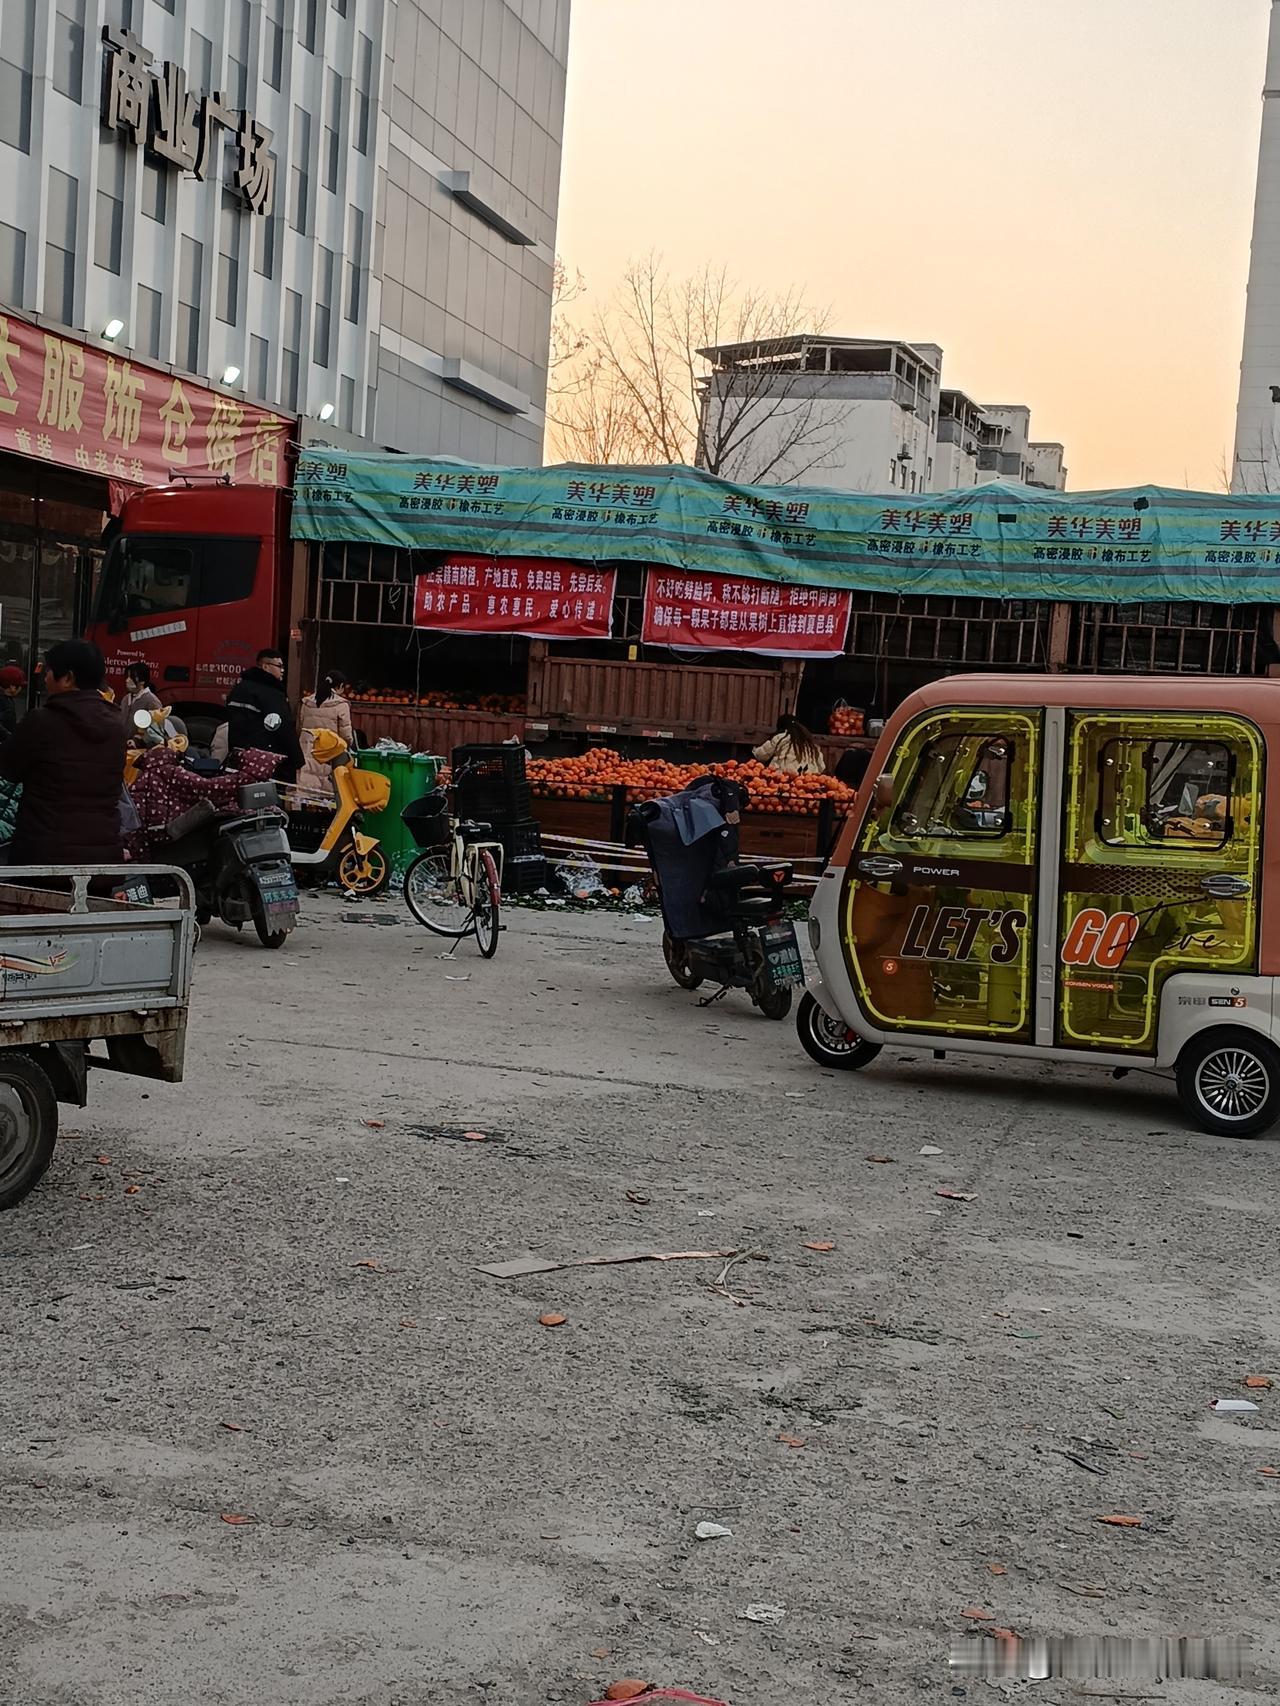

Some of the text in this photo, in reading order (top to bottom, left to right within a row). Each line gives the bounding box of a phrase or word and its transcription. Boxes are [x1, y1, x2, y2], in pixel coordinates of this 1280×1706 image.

[101, 25, 274, 216] 商业广场
[15, 427, 145, 483] 童装 中老年装
[414, 472, 499, 495] 美华美塑
[567, 480, 656, 507] 美华美塑
[399, 496, 505, 516] 高密浸胶 橡布工艺
[614, 512, 658, 525] 橡布工艺
[722, 495, 809, 524] 美华美塑
[707, 521, 817, 547] 高密浸胶 橡布工艺
[881, 509, 972, 535] 美华美塑
[1048, 516, 1142, 541] 美华美塑
[867, 538, 982, 557] 高密浸胶 橡布工艺
[1033, 545, 1152, 562] 高密浸胶 橡布工艺
[1205, 550, 1256, 564] 高密浸胶
[913, 866, 960, 877] POWER
[900, 904, 1140, 967] LET'S GO
